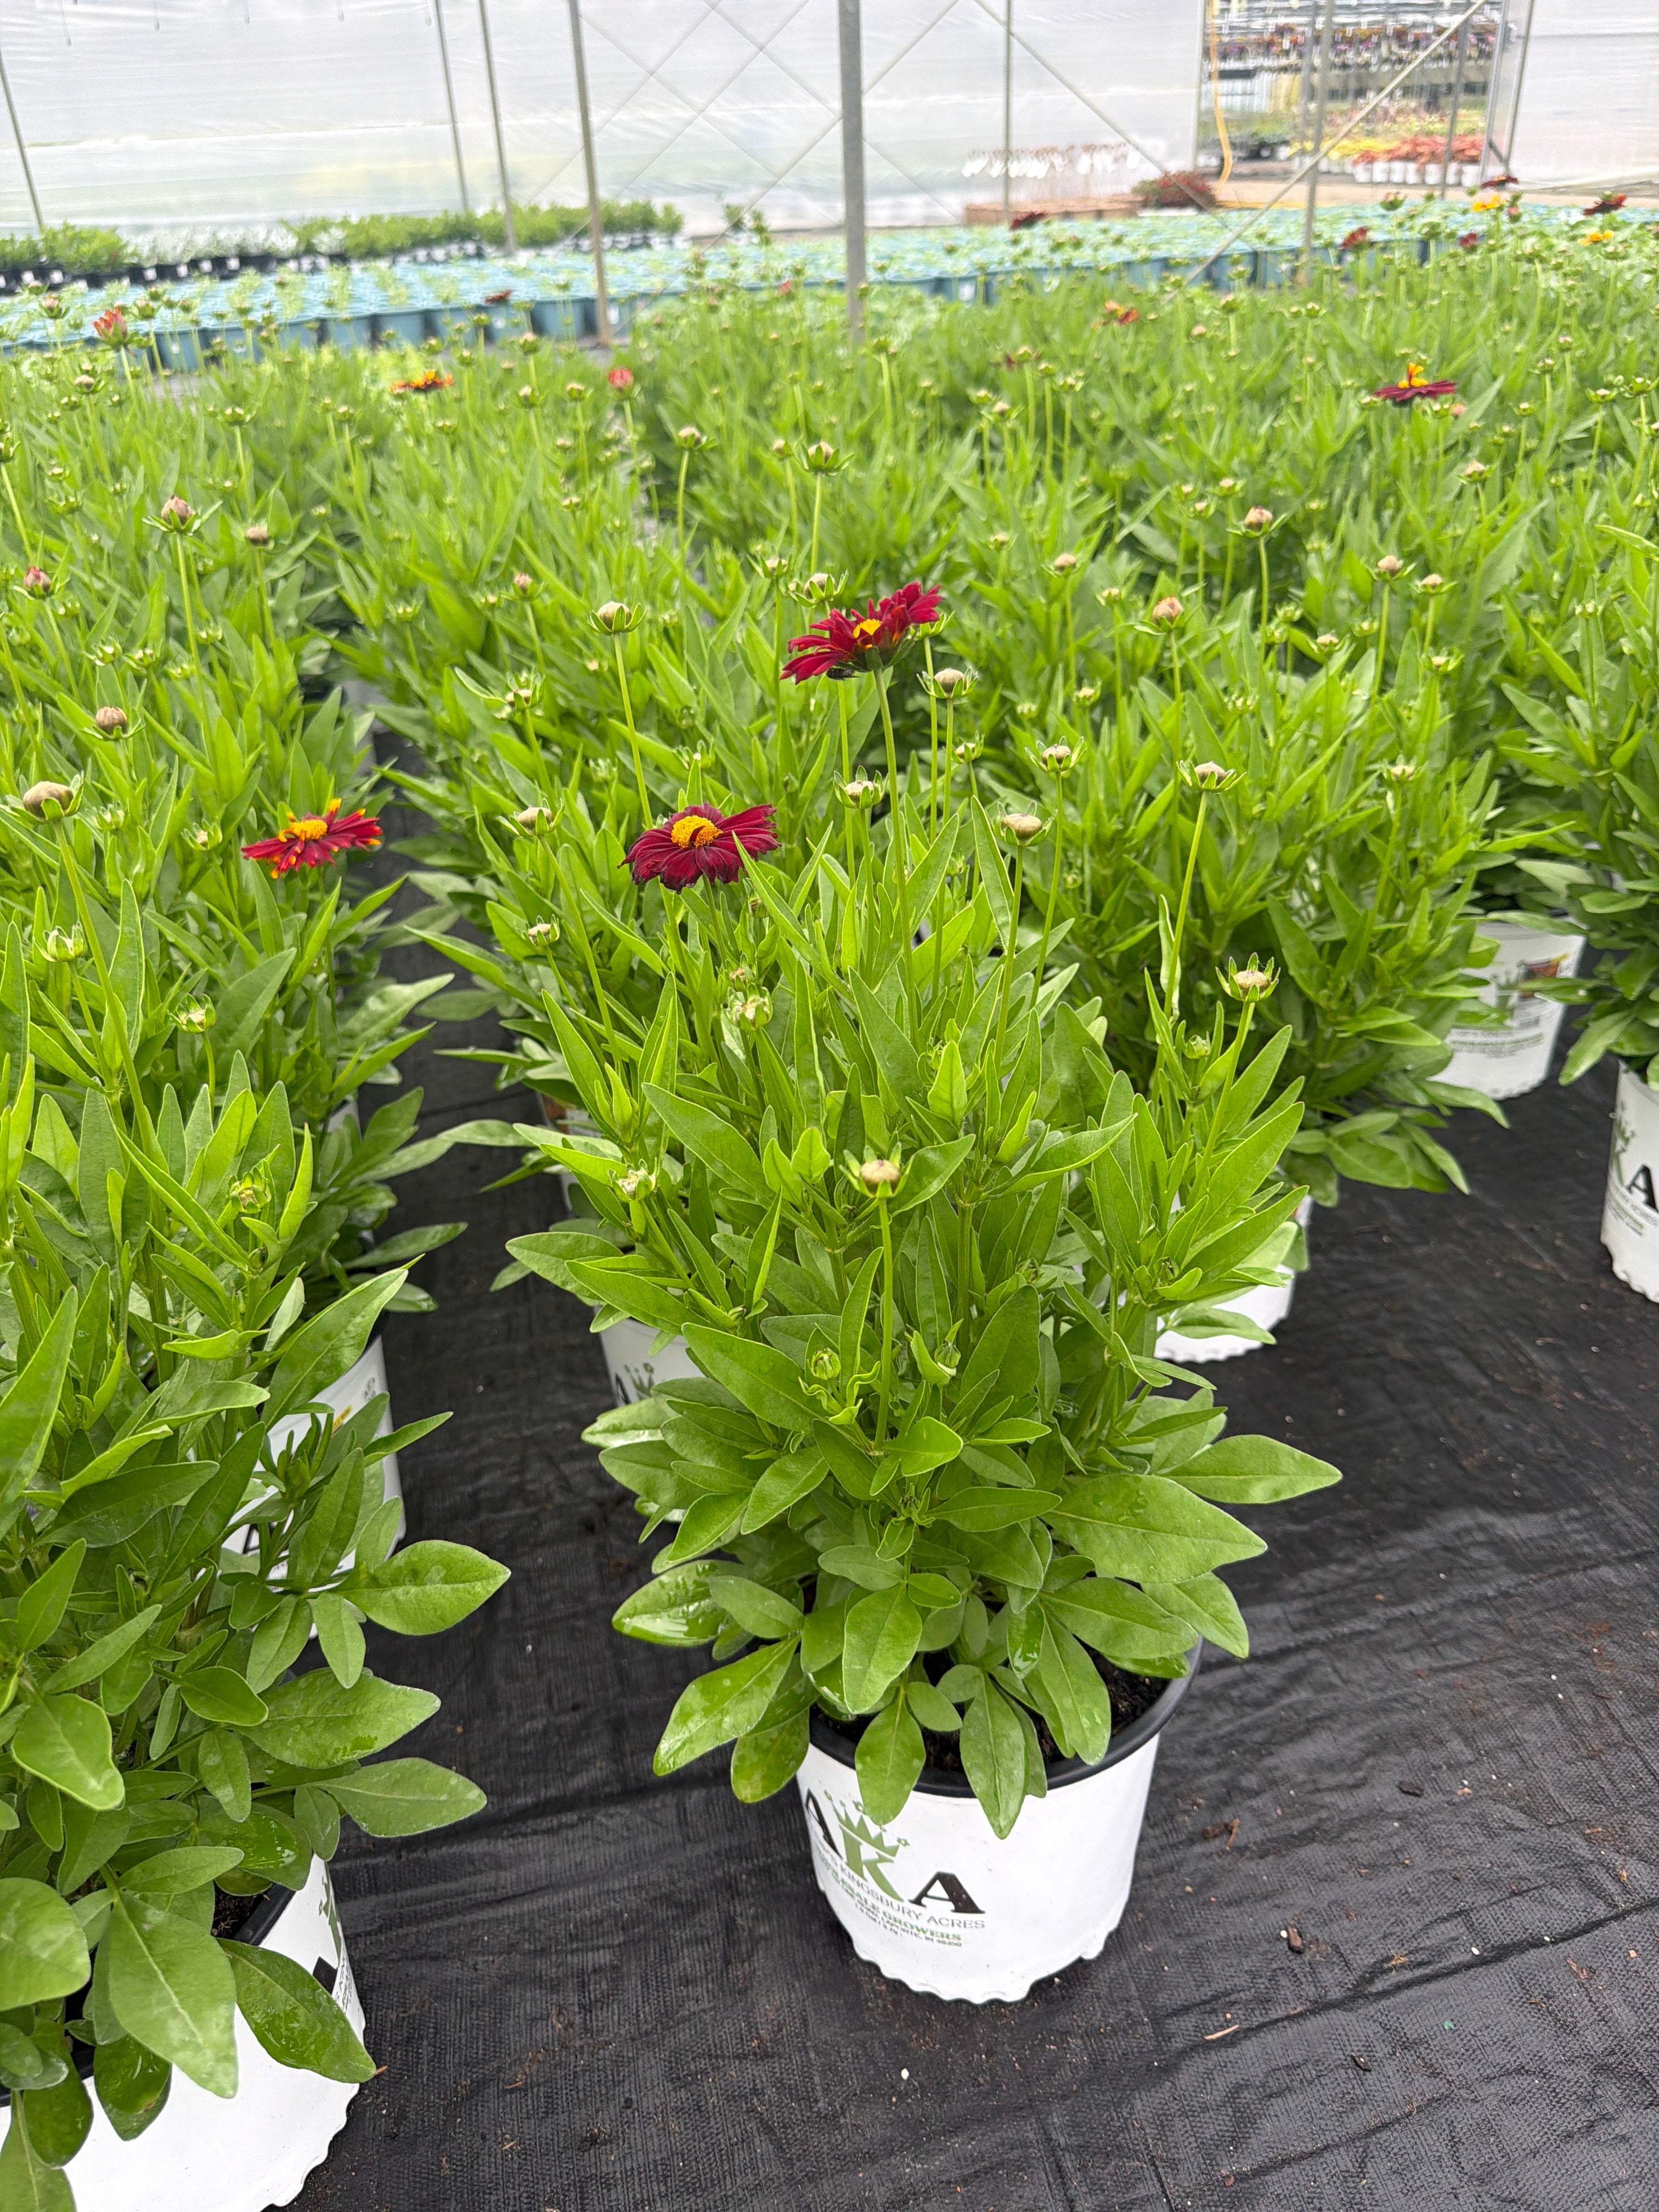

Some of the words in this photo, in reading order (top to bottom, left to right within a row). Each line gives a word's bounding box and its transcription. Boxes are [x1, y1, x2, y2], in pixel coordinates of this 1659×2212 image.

[839, 1862, 922, 1920] KINGSBURY
[927, 1915, 985, 1929] ACRES
[882, 1910, 962, 1941] GROWERS
